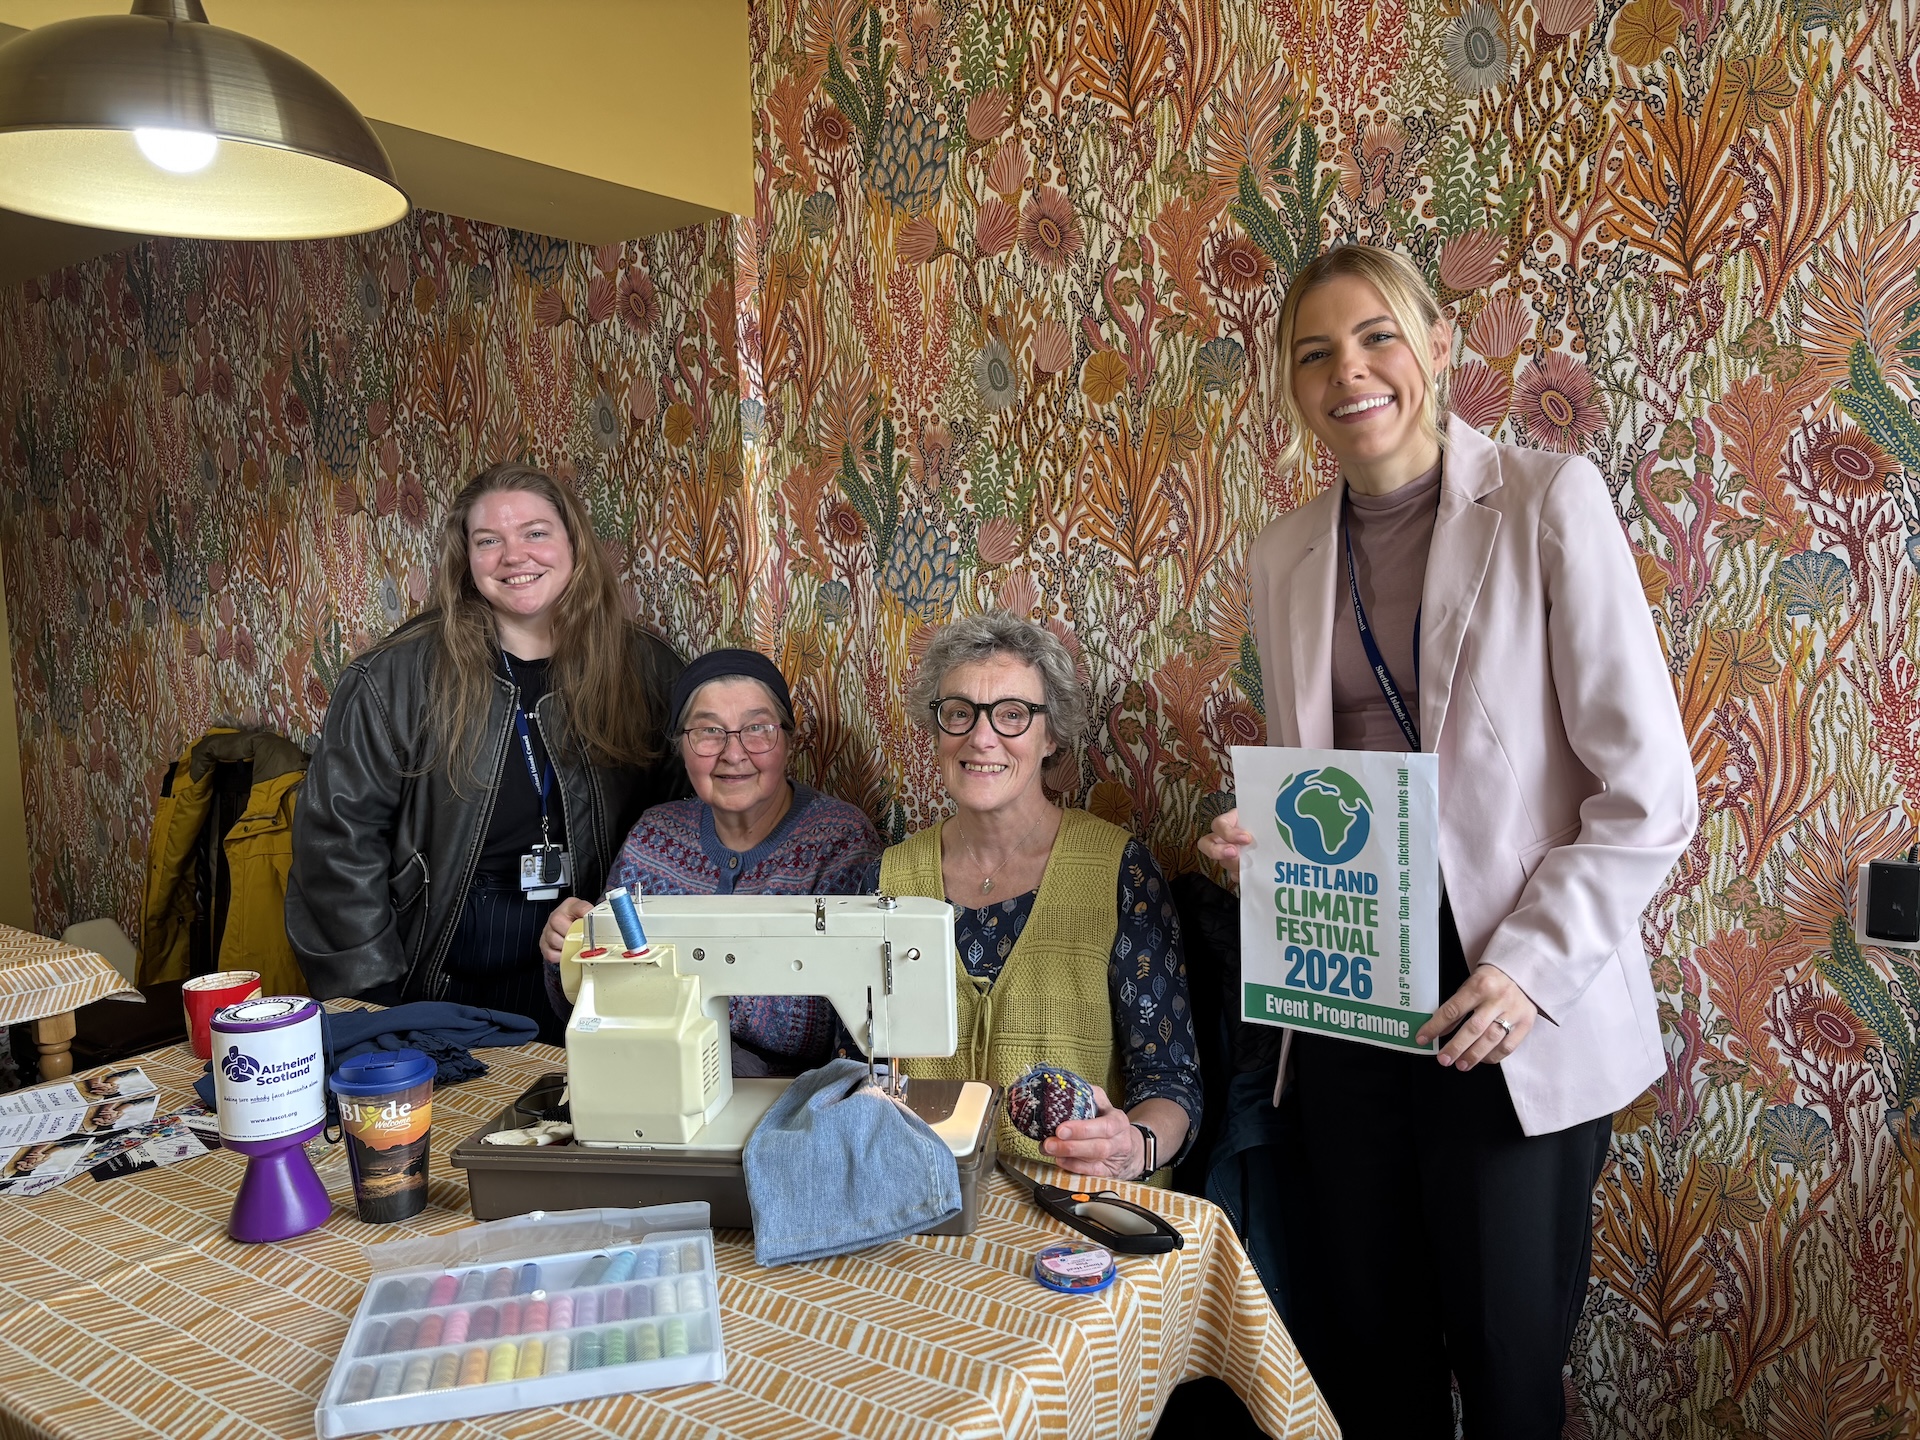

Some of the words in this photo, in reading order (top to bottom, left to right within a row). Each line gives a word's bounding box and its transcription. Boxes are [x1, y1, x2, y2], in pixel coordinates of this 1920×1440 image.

[1356, 605, 1367, 631] Council
[1375, 664, 1395, 697] Shetland
[1390, 695, 1406, 721] Islands
[1402, 720, 1419, 747] Council
[1397, 768, 1409, 787] Hall
[1397, 789, 1409, 819] Bowls
[1397, 821, 1410, 866] Clickimin
[1274, 861, 1378, 896] SHETLAND
[1398, 868, 1411, 921] 10am-4pm,
[1274, 886, 1379, 928] CLIMATE
[1276, 916, 1380, 957] FESTIVAL
[1399, 923, 1412, 976] September
[1284, 945, 1373, 1000] 2026
[1265, 993, 1310, 1020] Event
[1313, 1001, 1410, 1039] Programme
[1399, 991, 1411, 1007] Sat
[256, 1064, 310, 1086] Scotland
[261, 1052, 317, 1076] Alzheimer
[250, 1094, 270, 1104] nobody
[271, 1092, 285, 1102] faces
[286, 1085, 308, 1096] dementia
[374, 1117, 411, 1130] Welcome
